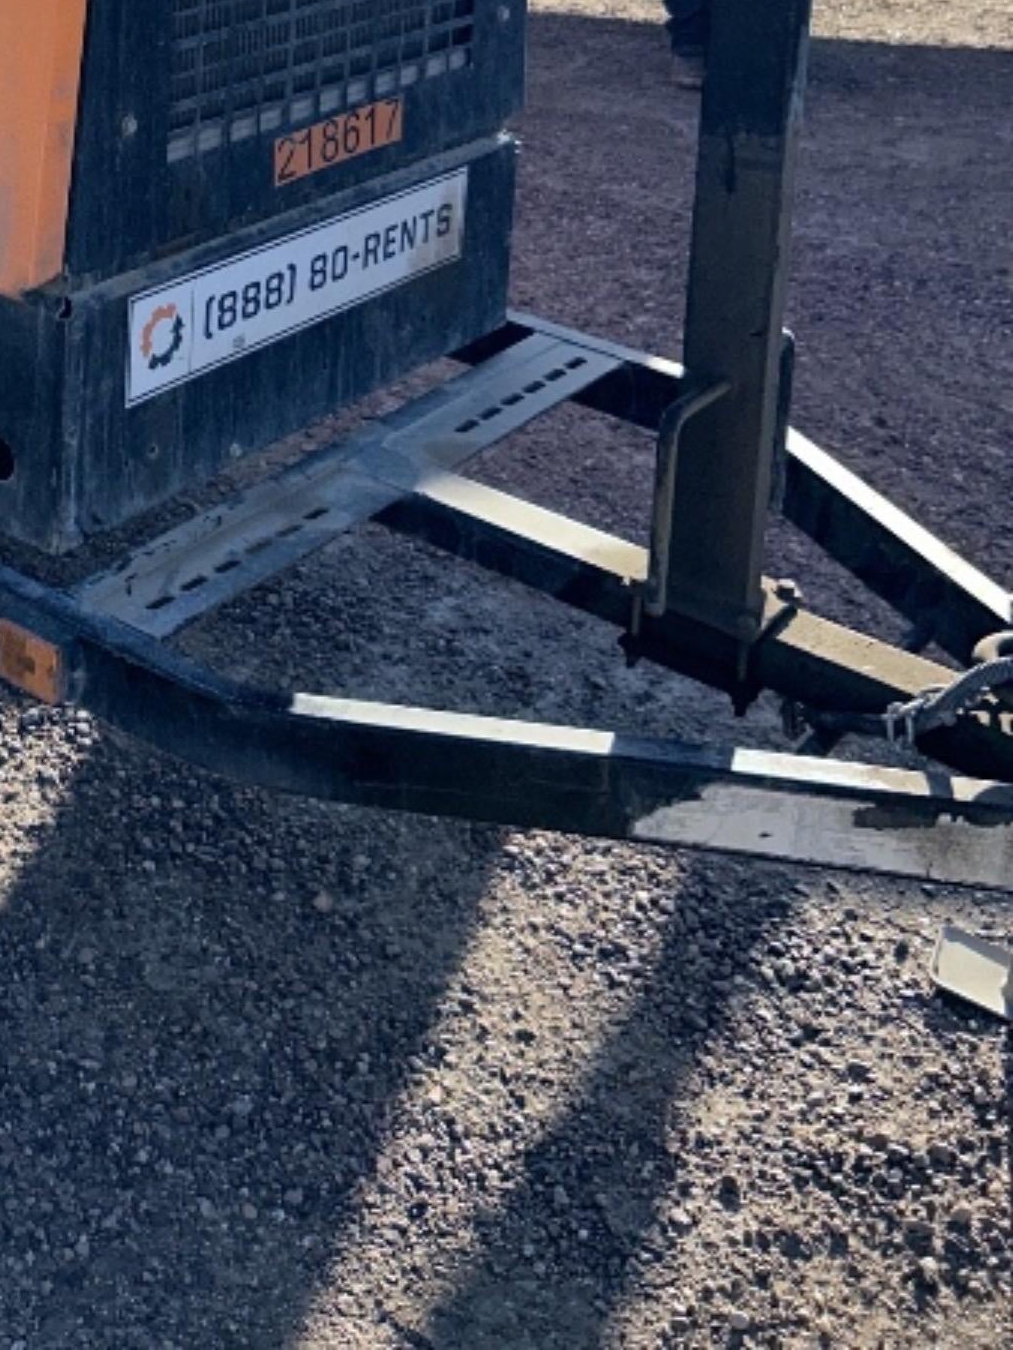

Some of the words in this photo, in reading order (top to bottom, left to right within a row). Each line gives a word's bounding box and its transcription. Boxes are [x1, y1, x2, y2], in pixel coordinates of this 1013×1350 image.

[277, 97, 400, 183] 218617
[204, 262, 298, 340] (888)
[308, 202, 454, 292] 80-RENTS
